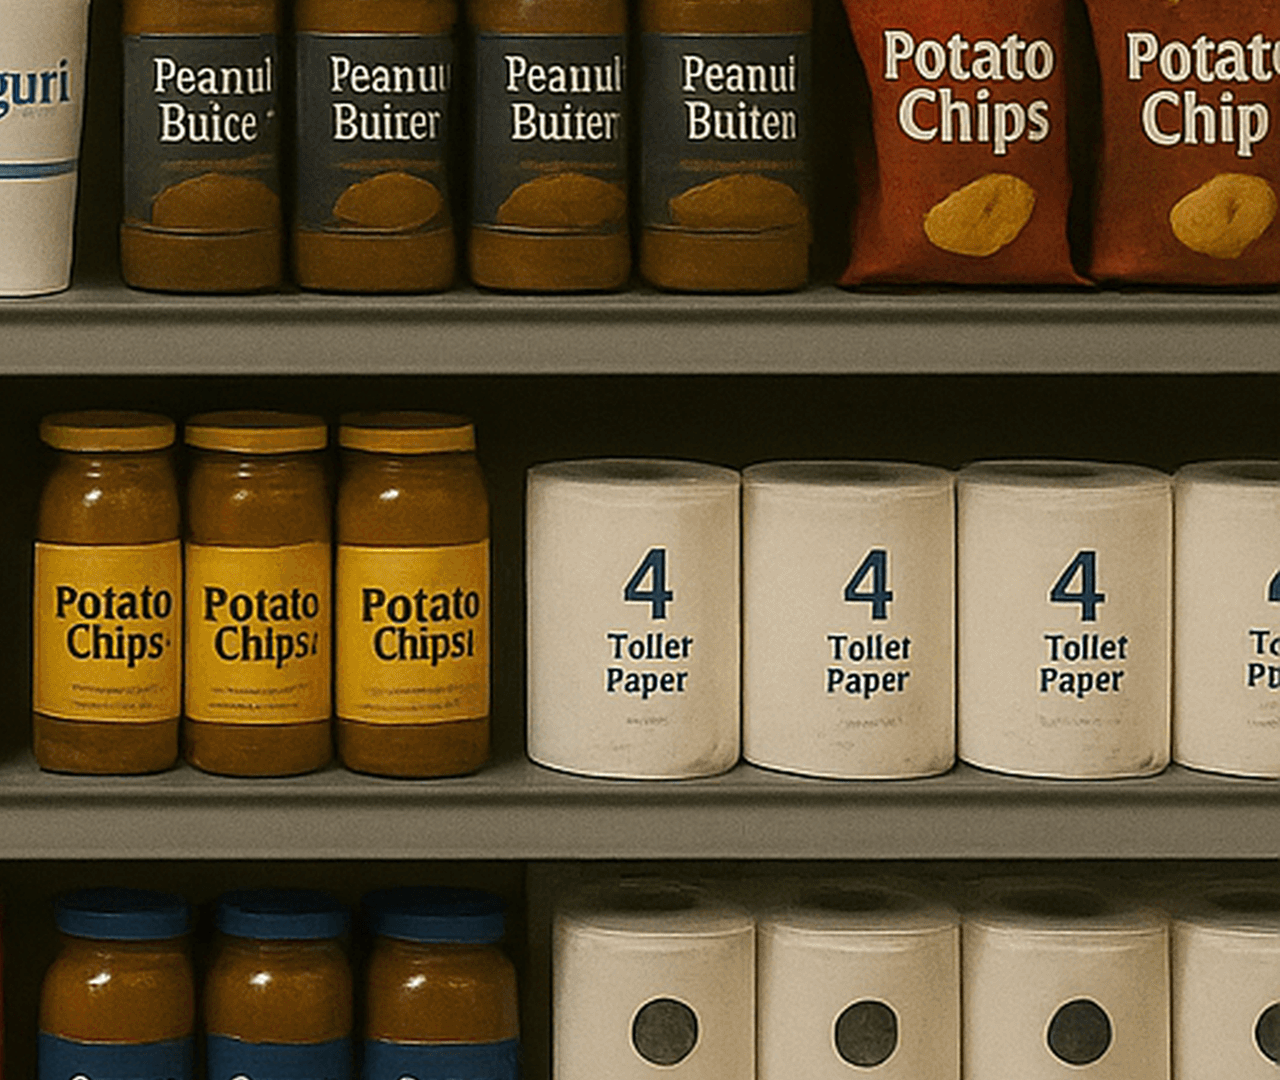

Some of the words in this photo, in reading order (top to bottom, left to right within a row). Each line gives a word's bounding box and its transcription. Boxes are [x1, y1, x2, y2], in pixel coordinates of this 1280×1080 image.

[884, 30, 1054, 80] Potato
[898, 88, 1049, 156] Chips
[1142, 90, 1269, 157] Chip
[56, 586, 171, 620] Potato
[204, 587, 318, 622] Potato
[362, 587, 479, 623] Potato
[624, 548, 673, 620] 4
[844, 549, 893, 620] 4
[1050, 550, 1106, 622] 4
[606, 668, 688, 699] Paper
[827, 669, 910, 699] Paper
[1040, 668, 1124, 698] Paper
